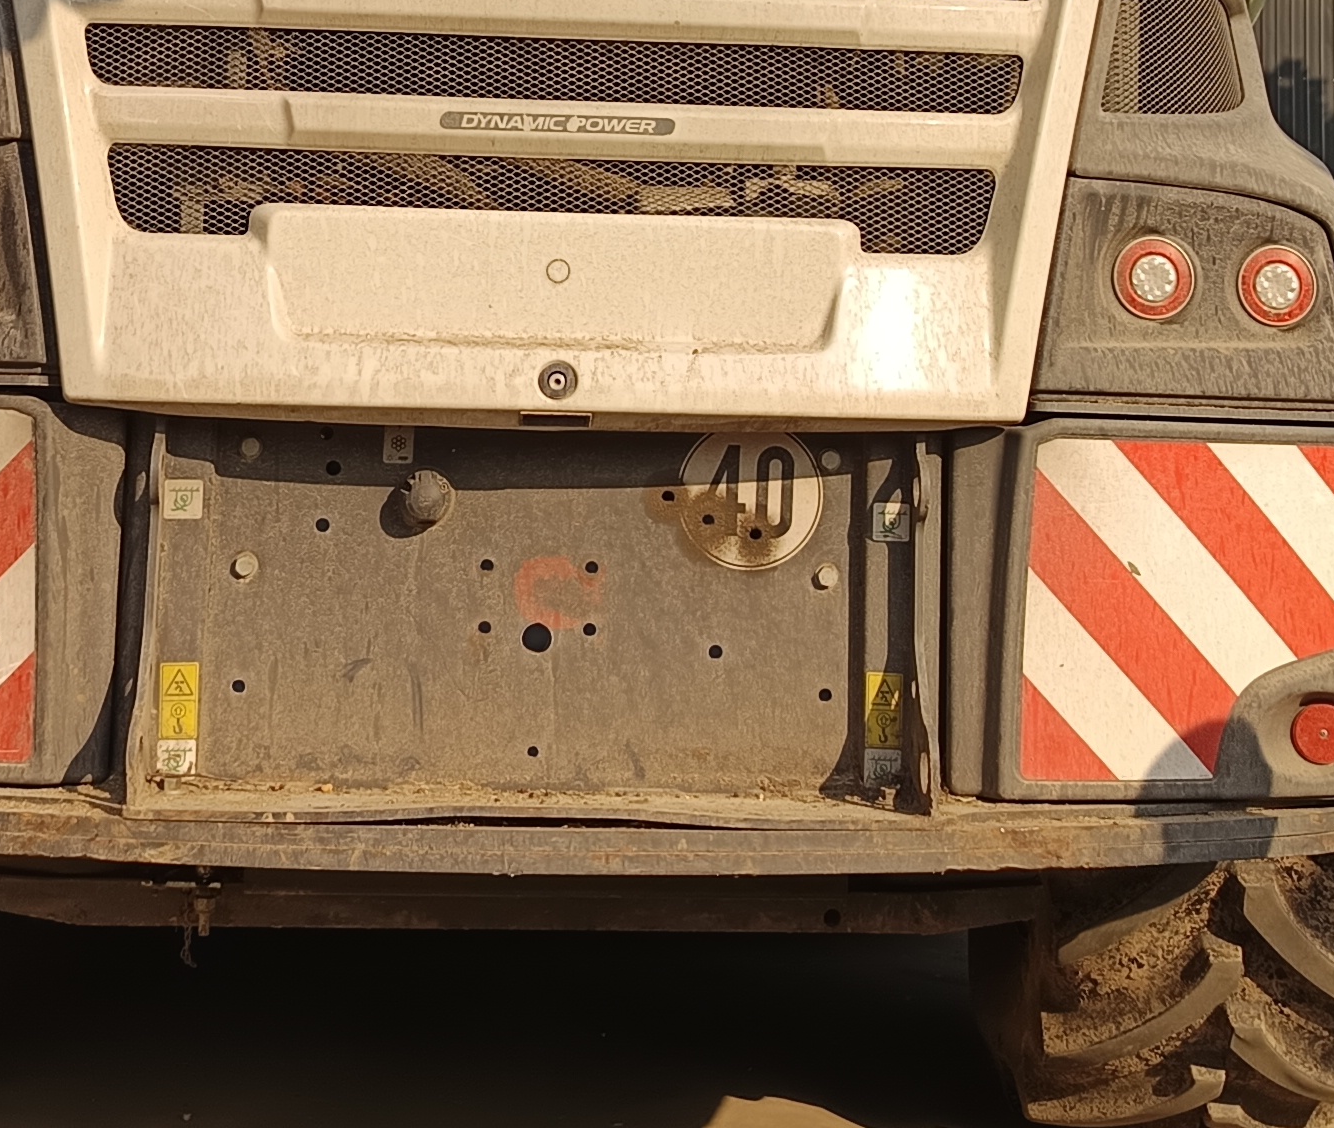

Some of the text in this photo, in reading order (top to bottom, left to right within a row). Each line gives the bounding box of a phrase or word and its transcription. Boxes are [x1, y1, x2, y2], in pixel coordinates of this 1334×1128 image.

[460, 113, 657, 134] DYNAMIC POWER
[701, 444, 795, 539] 40
